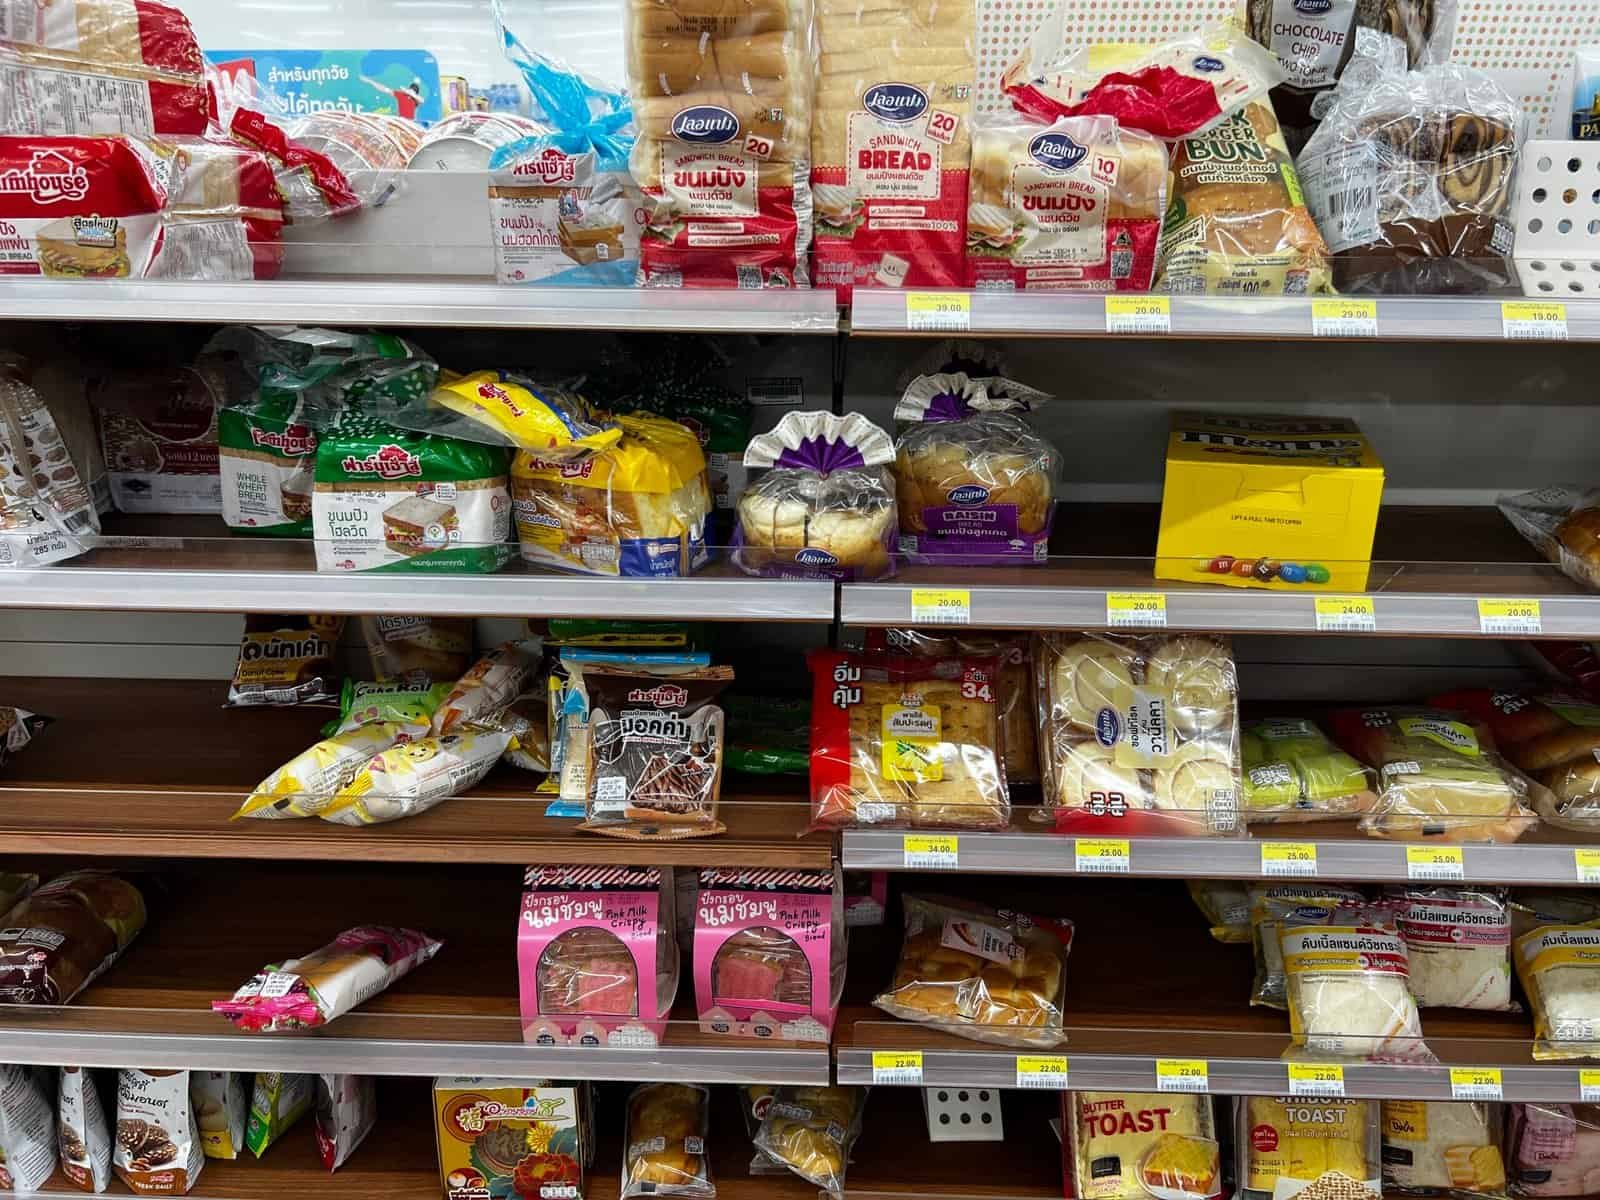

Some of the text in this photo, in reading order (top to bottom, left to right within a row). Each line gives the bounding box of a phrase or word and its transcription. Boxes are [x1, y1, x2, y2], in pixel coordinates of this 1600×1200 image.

[1273, 23, 1345, 46] CHOCOLATE
[1291, 42, 1320, 58] CHIP
[268, 64, 348, 86] สำหรับทุกวัย
[933, 114, 955, 131] 20
[747, 138, 770, 155] 20
[869, 134, 922, 152] SANDWICH
[1184, 139, 1266, 161] BUN
[674, 153, 745, 168] SANDWICH BREAD
[858, 150, 932, 170] BREAD
[1097, 158, 1115, 174] 10
[673, 166, 746, 187] ขนมปัง
[1024, 181, 1096, 194] SANDWICH BREAD
[1023, 193, 1096, 211] ขนมปัง
[936, 304, 962, 312] 39.00
[1135, 306, 1161, 314] 20.00
[1341, 310, 1368, 318] 29.00
[1532, 312, 1558, 321] 19.00
[237, 471, 268, 482] WHOLE
[237, 480, 267, 492] WHEAT
[238, 490, 267, 501] BREAD
[328, 508, 368, 522] ขนมปัง
[943, 510, 997, 522] RAISIN
[33, 544, 49, 556] 285
[938, 599, 962, 607] 20.00
[1134, 602, 1158, 610] 20.00
[1342, 606, 1367, 614] 24.00
[1507, 608, 1532, 617] 20.00
[833, 661, 861, 682] อิ่ม
[832, 687, 861, 709] คุ้ม
[962, 682, 992, 702] 34
[622, 712, 686, 737] มอคค่า
[928, 845, 951, 853] 34.00
[1100, 849, 1123, 857] 25.00
[1287, 852, 1309, 860] 25.00
[1433, 855, 1456, 863] 25.00
[523, 898, 603, 928] นมชมพู
[606, 905, 647, 919] Pink Milk
[700, 899, 777, 926] นมชมพู
[779, 907, 820, 920] Pink Milk
[611, 918, 647, 931] Crispy
[785, 920, 820, 933] Crispy
[1301, 934, 1401, 951] ดับเบิ้ลแซนด์วิชกระ
[1542, 931, 1600, 947] ดับเบิ้ลแซน
[896, 1060, 916, 1068] 22.00
[1040, 1065, 1061, 1073] 22.00
[1314, 1073, 1336, 1081] 22.00
[1473, 1077, 1494, 1085] 22.00
[1083, 1100, 1125, 1114] BUTTER
[457, 1106, 485, 1131] 福
[1084, 1108, 1171, 1138] TOAST
[1286, 1108, 1346, 1124] TOAST
